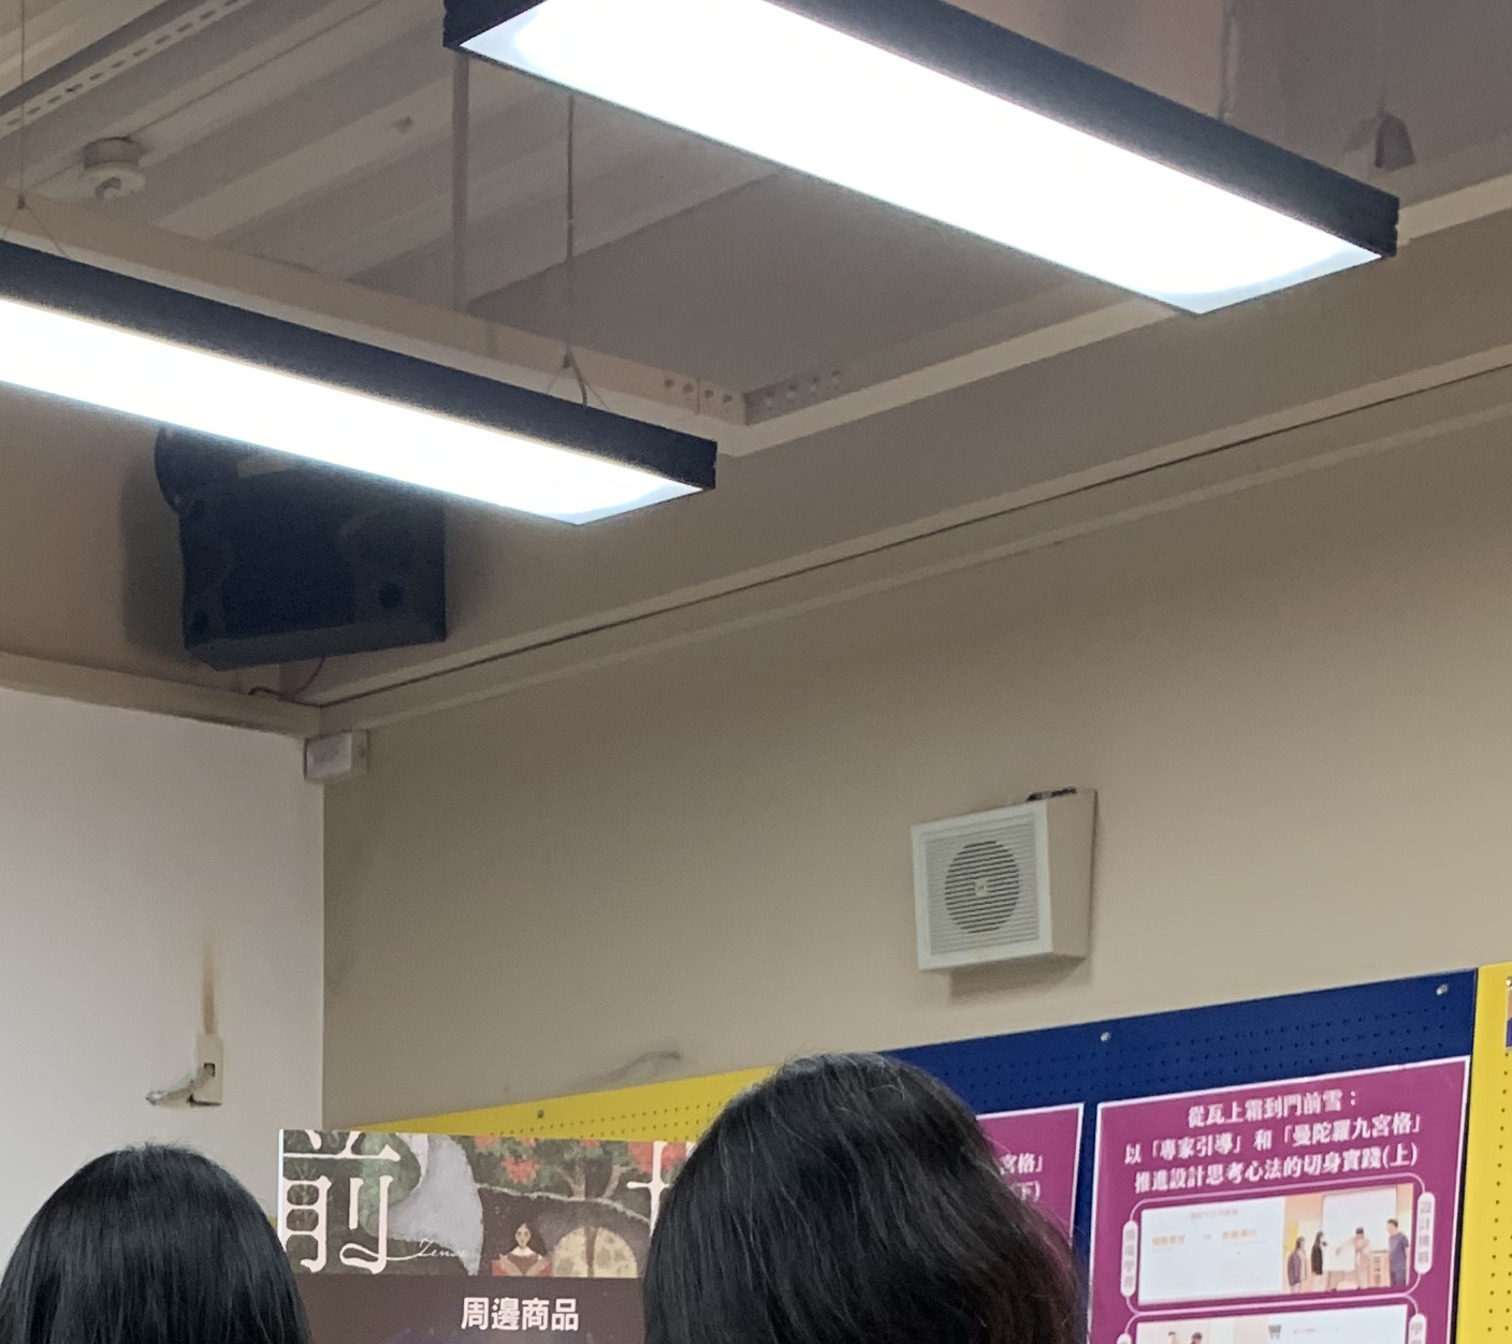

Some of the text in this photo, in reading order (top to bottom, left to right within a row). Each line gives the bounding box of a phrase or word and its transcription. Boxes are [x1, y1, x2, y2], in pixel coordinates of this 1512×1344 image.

[1134, 1143, 1419, 1194] 推進設計思考心法的切身實踐(上)
[461, 1297, 579, 1331] 周邊商品
